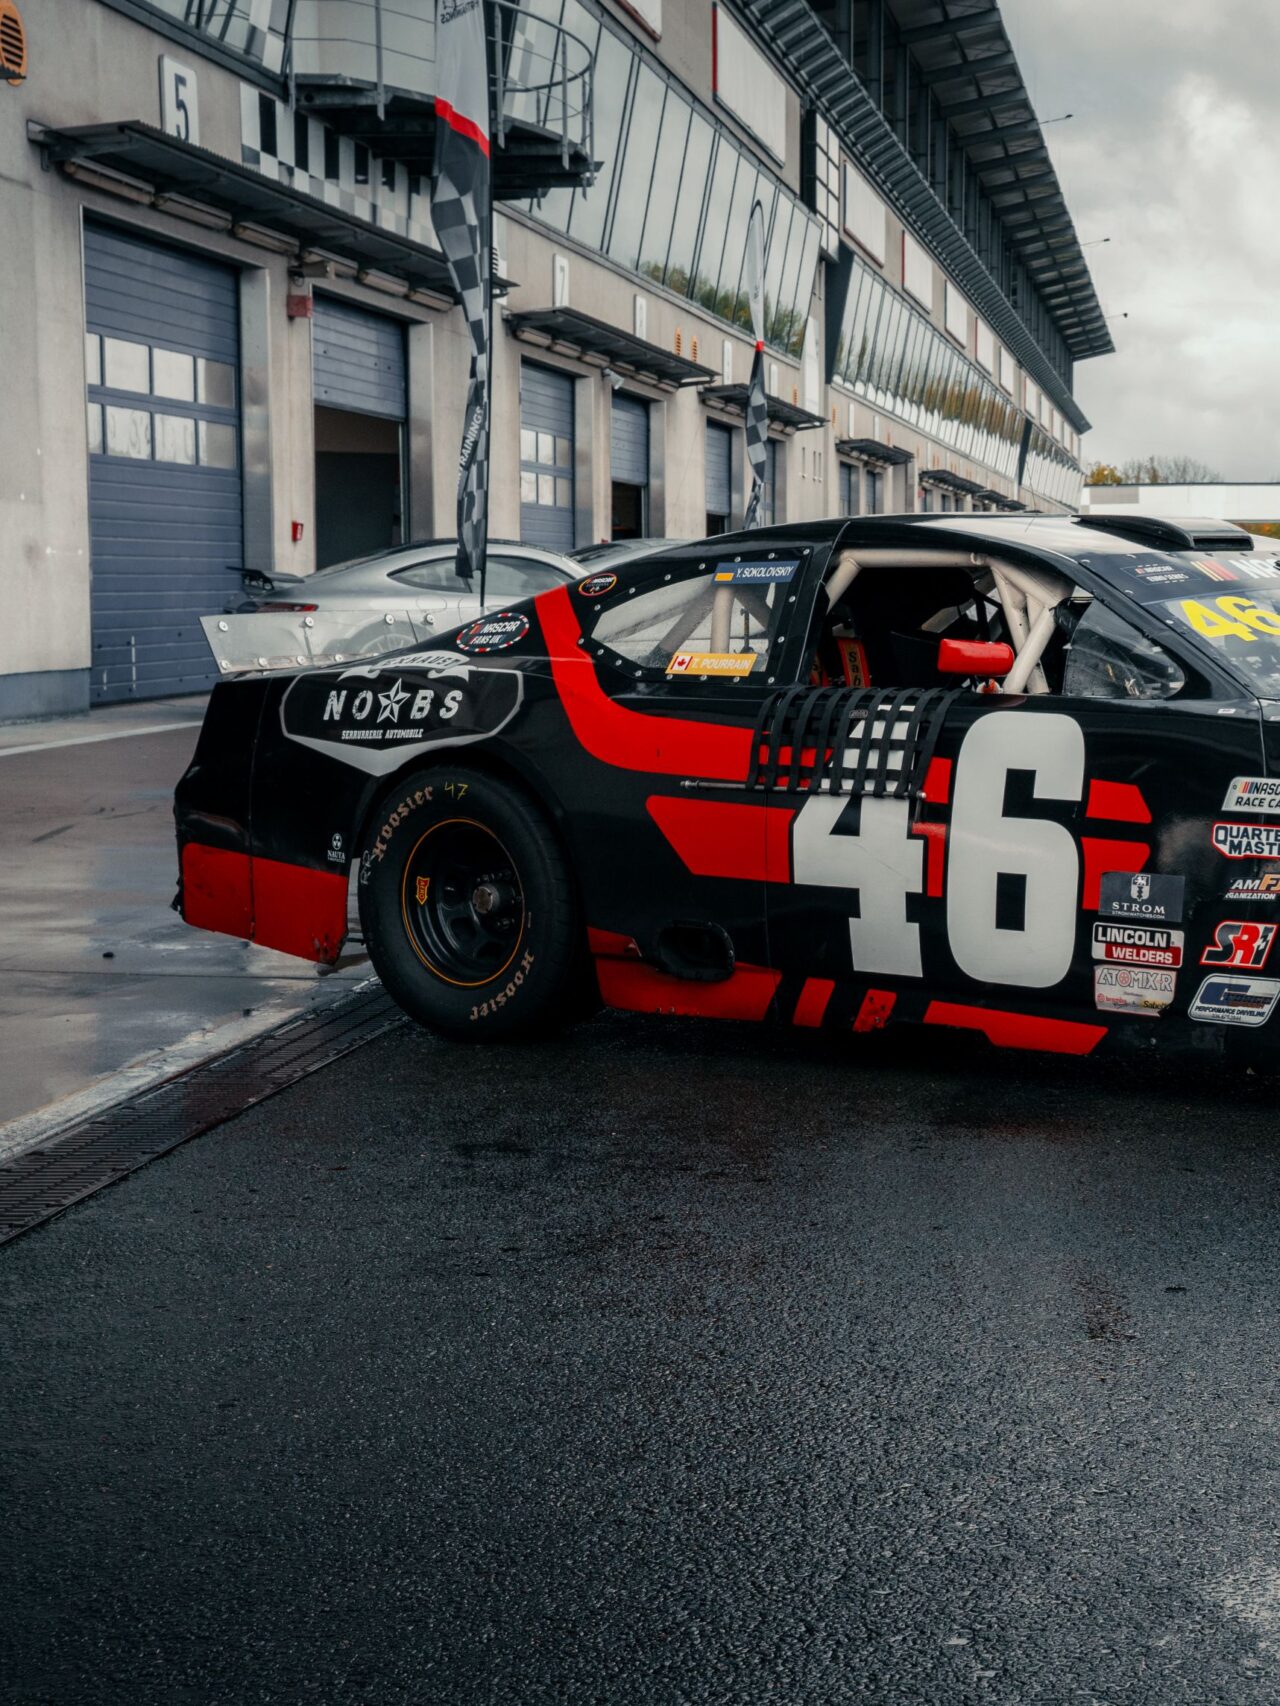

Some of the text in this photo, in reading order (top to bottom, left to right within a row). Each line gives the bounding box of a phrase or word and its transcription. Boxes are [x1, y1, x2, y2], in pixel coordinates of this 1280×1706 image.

[174, 72, 190, 144] 5
[742, 566, 794, 577] SOKOLOVSKIY
[480, 620, 521, 634] NASCAR
[470, 633, 502, 645] FANS UK
[382, 654, 462, 668] EXHAUST
[700, 658, 751, 670] POURRAIN
[385, 728, 424, 739] AUTOMOBILE
[444, 781, 469, 800] 47
[1235, 796, 1266, 808] RACE
[373, 786, 433, 862] Hoosier
[793, 703, 1086, 988] 46
[327, 850, 346, 860] NAUTA
[1112, 902, 1165, 914] STROM
[1097, 926, 1167, 948] LINCOLN
[1112, 946, 1173, 964] WELDERS
[1195, 1005, 1236, 1015] PERFORMANCE
[1236, 1009, 1266, 1018] DRIVELINE
